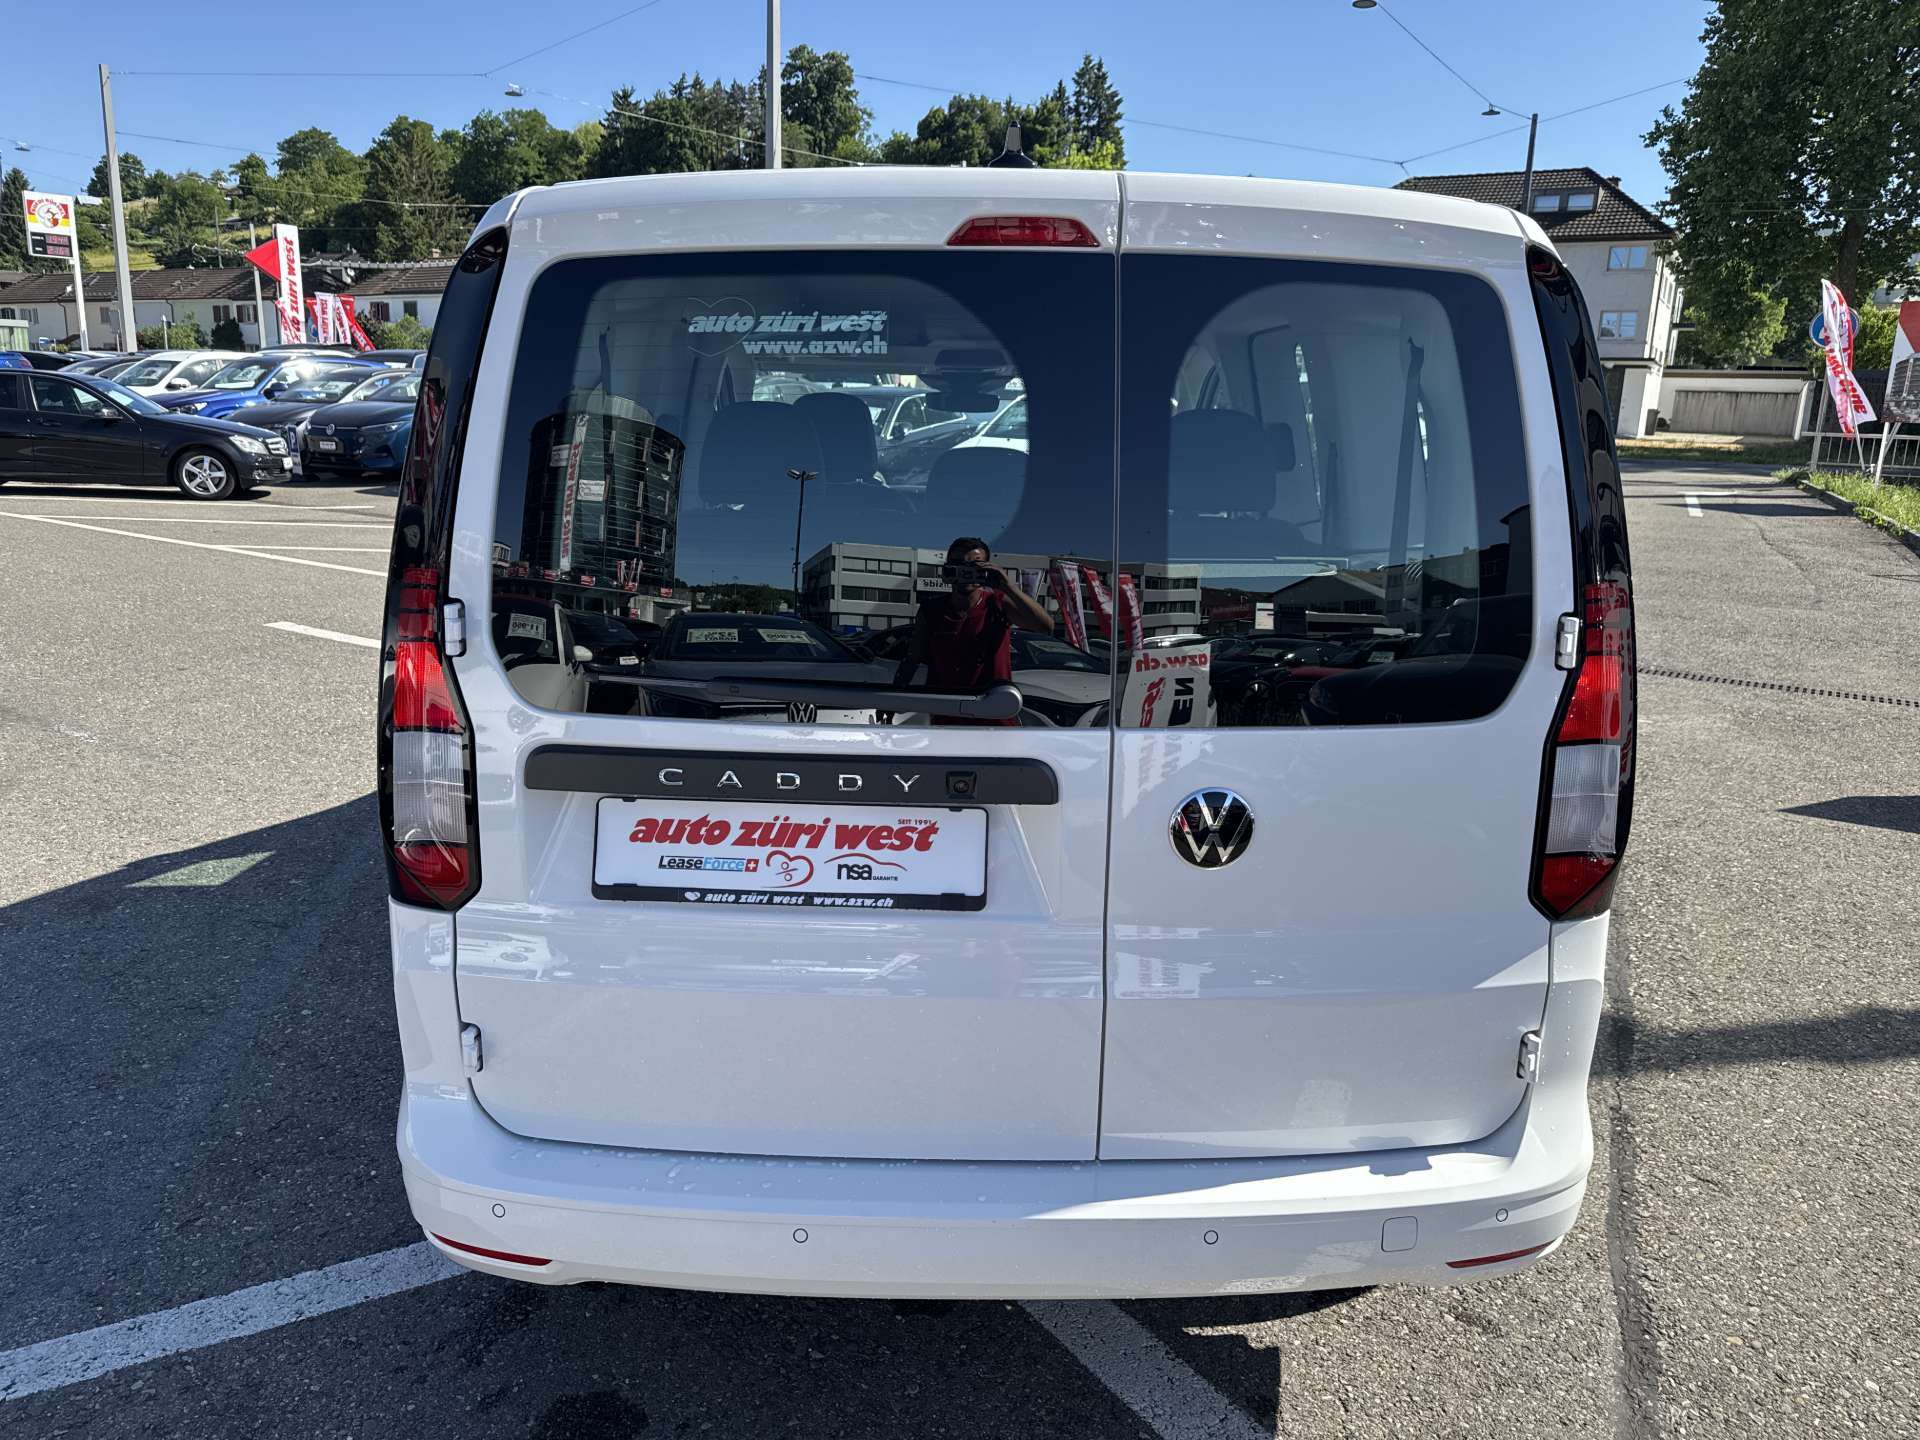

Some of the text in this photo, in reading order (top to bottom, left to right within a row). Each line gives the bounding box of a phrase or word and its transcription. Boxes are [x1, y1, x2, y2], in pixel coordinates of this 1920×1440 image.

[284, 236, 296, 277] west
[688, 310, 888, 333] auto züri west
[742, 334, 889, 355] www.azw.ch
[657, 767, 921, 793] CADDY
[628, 813, 940, 852] auto züri west
[657, 855, 745, 872] LeaseForce
[836, 863, 873, 881] nsa
[704, 892, 895, 908] auto züri west www.azw.ch
